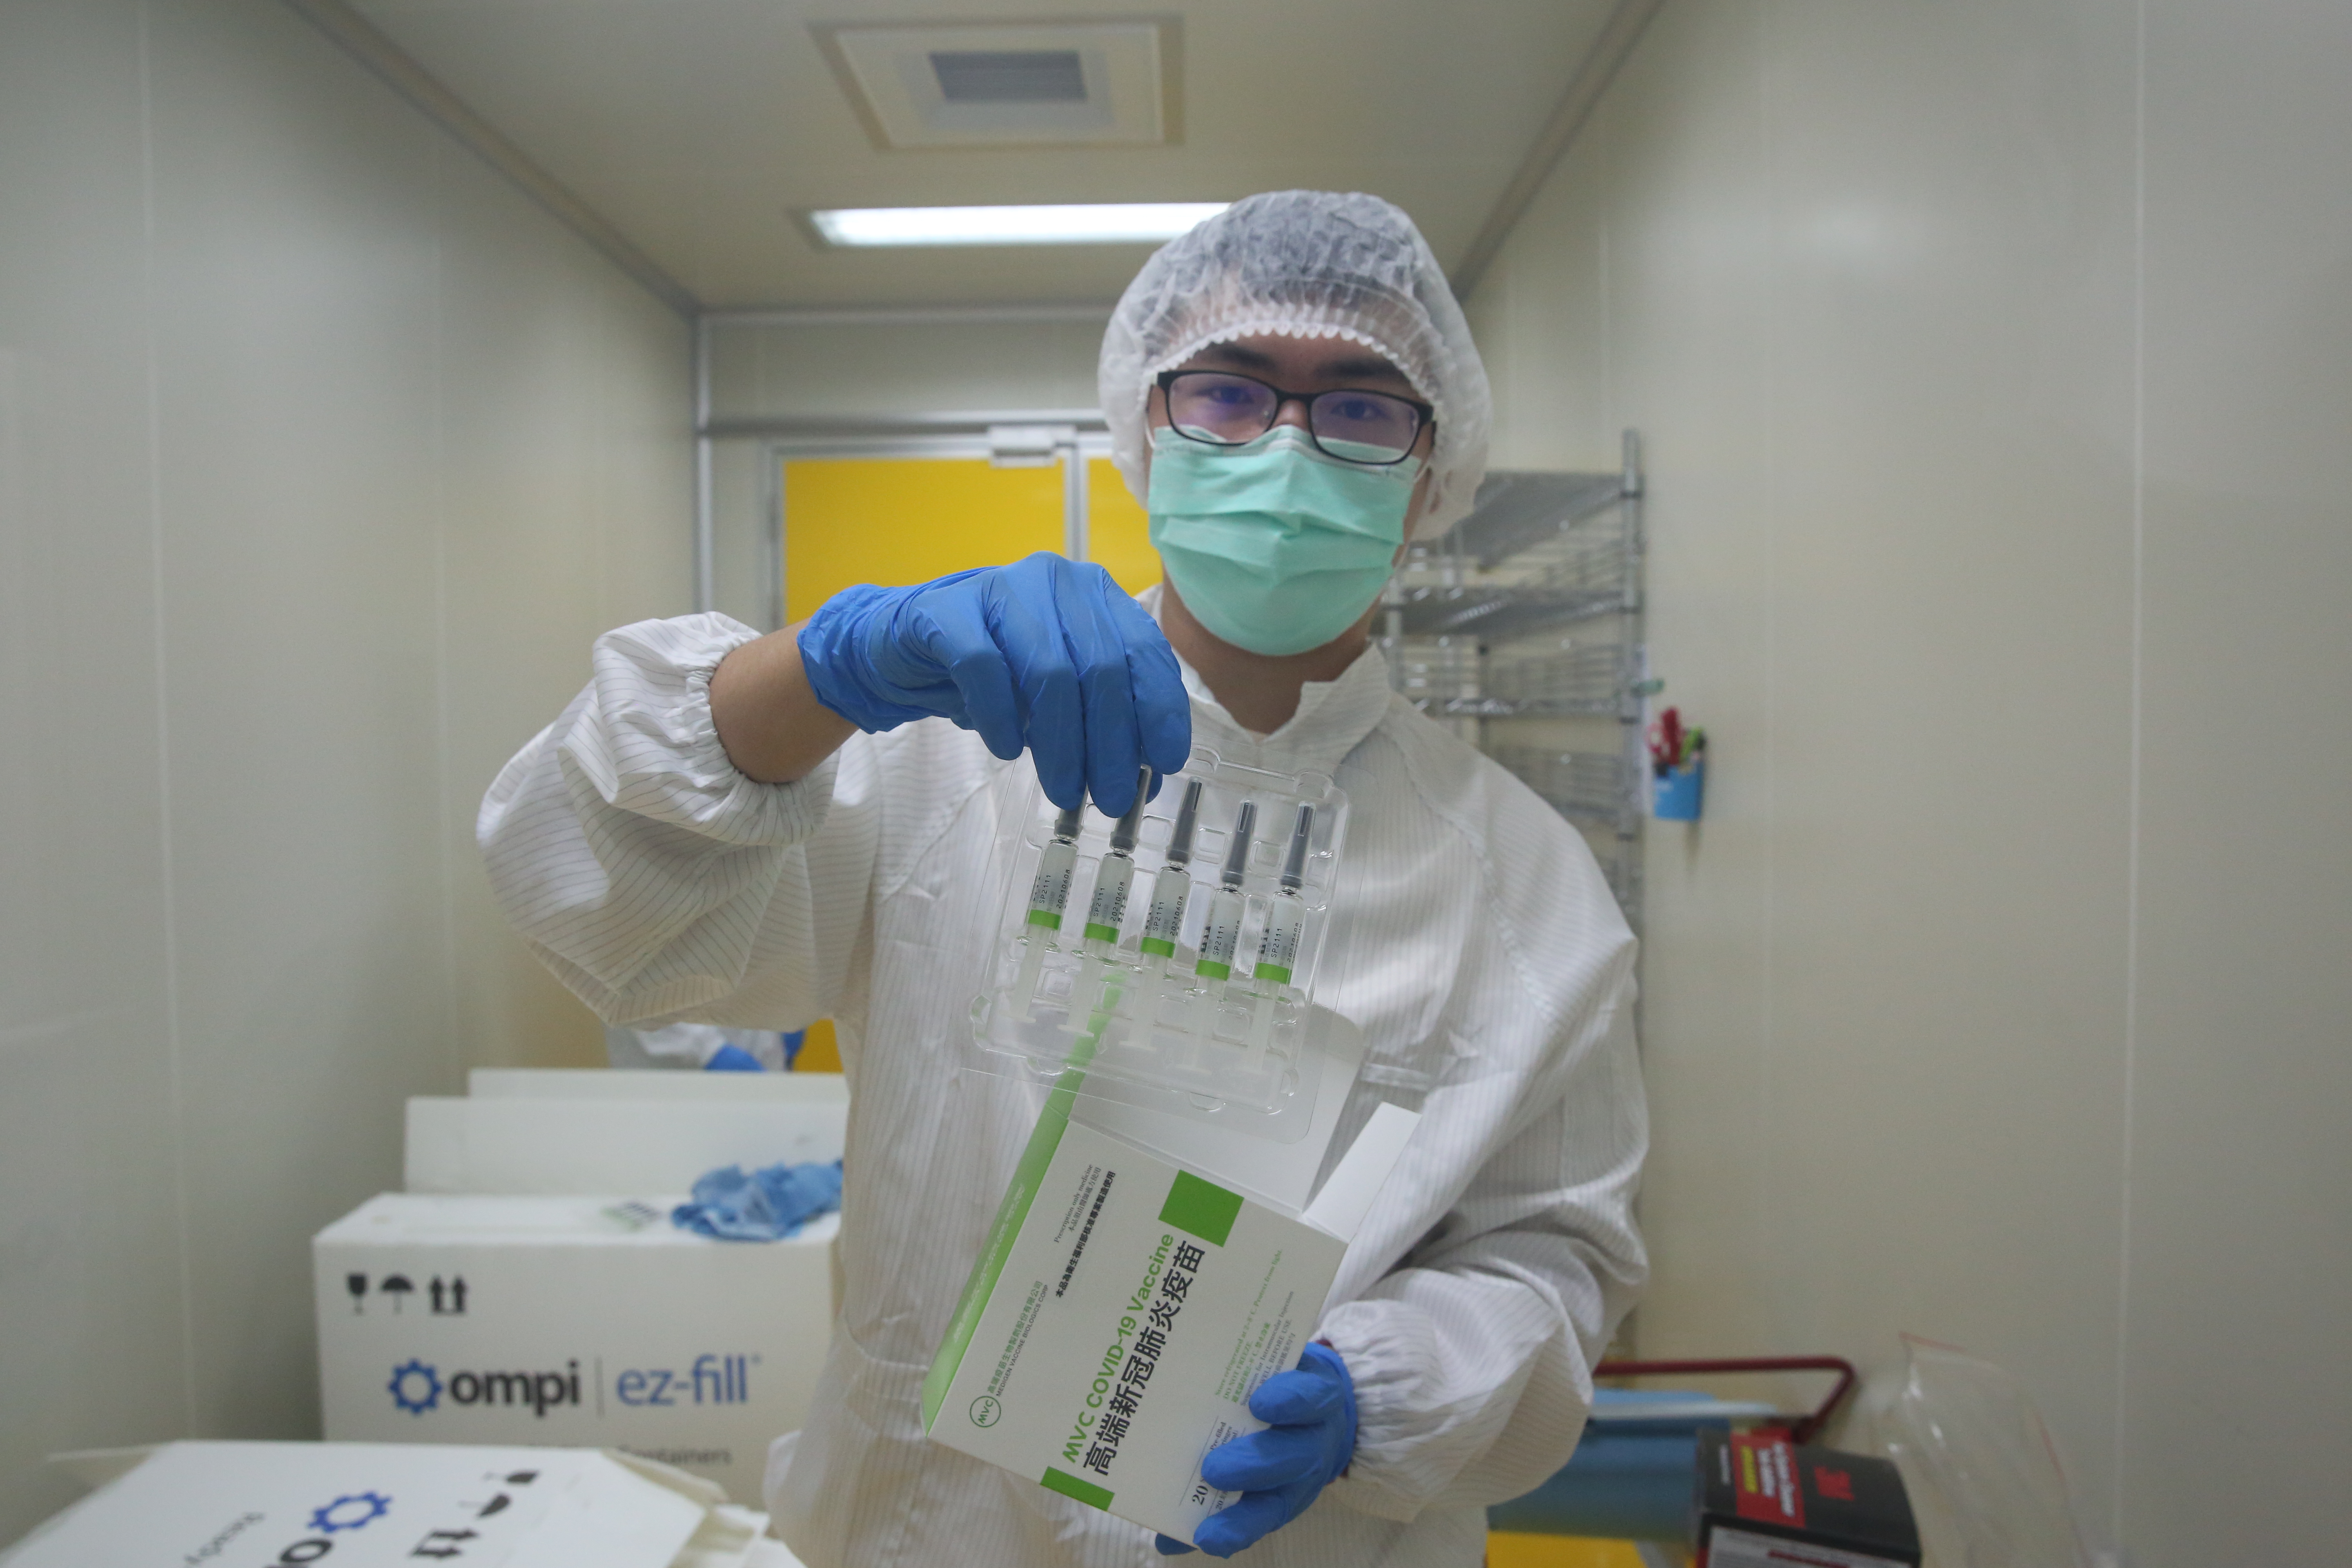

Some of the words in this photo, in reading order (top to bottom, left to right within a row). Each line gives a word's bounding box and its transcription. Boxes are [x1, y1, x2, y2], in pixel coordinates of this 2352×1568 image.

[1039, 874, 1051, 904] SP2111
[1056, 869, 1070, 908] 20210608
[1094, 887, 1105, 916] SP2111
[1111, 882, 1124, 920] 20210608
[1153, 902, 1163, 931] SP2111
[1170, 896, 1183, 935] 20210608
[1213, 926, 1224, 955] SP2111
[1271, 928, 1282, 957] SP2111
[1054, 1206, 1074, 1243] Prescription
[1071, 1192, 1080, 1205] only
[1078, 1164, 1092, 1191] medicine
[996, 1368, 1011, 1396] MEDIGEN
[1010, 1339, 1025, 1366] VACCINE
[1023, 1303, 1040, 1337] BIOLOGICS
[1039, 1285, 1049, 1302] CORP
[1223, 1338, 1243, 1377] refrigerated
[1254, 1283, 1267, 1306] Protect
[1264, 1266, 1274, 1282] from
[1062, 1410, 1094, 1461] MVC
[1086, 1315, 1136, 1408] COVID-19
[1127, 1232, 1173, 1314] Vaccine
[1082, 1241, 1204, 1476] 高端新冠肺炎疫苗
[1240, 1372, 1258, 1406] Suspension
[1261, 1319, 1281, 1360] Intramuscular
[1279, 1291, 1294, 1317] Injection
[1269, 1335, 1284, 1362] BEFORE
[449, 1359, 580, 1418] ompi
[1223, 1388, 1231, 1399] DO
[1229, 1371, 1238, 1386] NOT
[978, 1400, 993, 1423] MVC
[1192, 1484, 1208, 1504] 20
